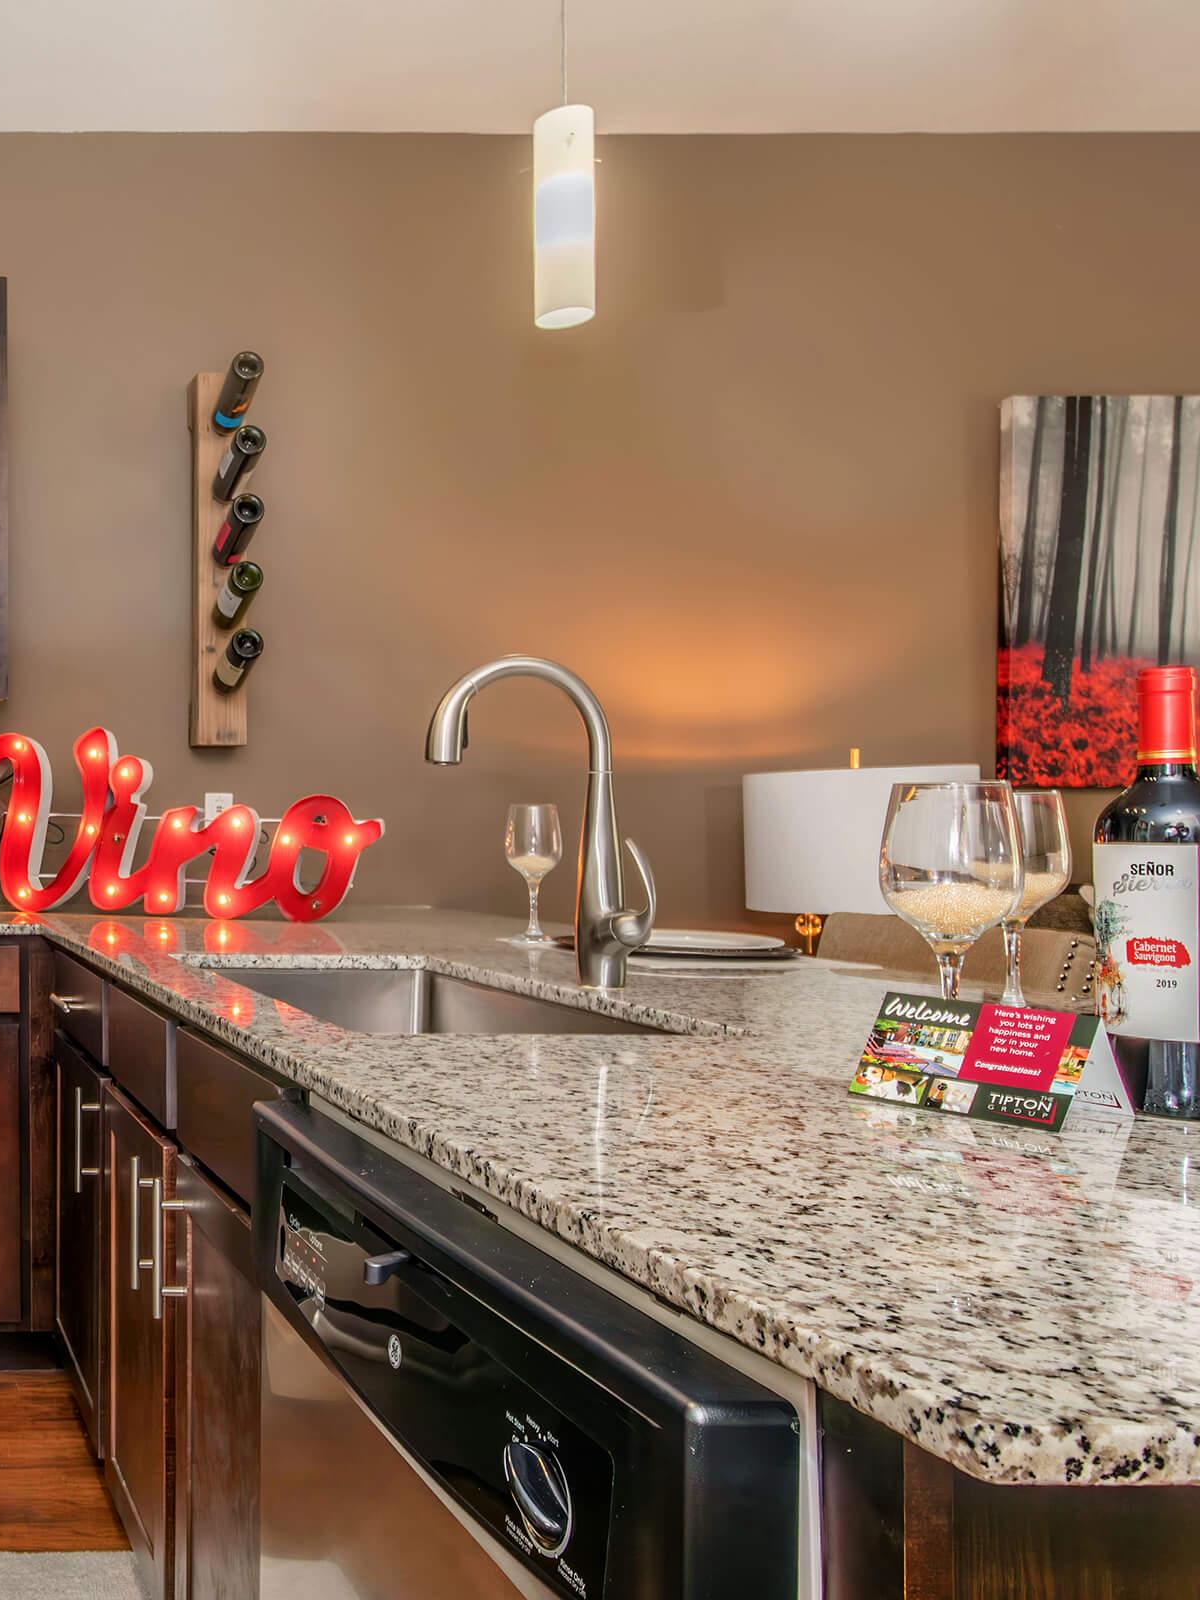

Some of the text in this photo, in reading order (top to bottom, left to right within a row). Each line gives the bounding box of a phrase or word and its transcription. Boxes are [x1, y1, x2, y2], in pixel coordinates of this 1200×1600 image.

[1130, 861, 1175, 876] SEÑOR
[1133, 940, 1177, 954] Cabernet
[1133, 951, 1176, 964] Sauvignon
[1155, 978, 1178, 989] 2019
[885, 997, 972, 1026] Welcome
[994, 1008, 1057, 1025] Here's wishing
[999, 1020, 1045, 1032] you lots of
[988, 1026, 1051, 1042] happiness and
[993, 1036, 1039, 1049] joy in your
[989, 1045, 1036, 1058] new home.
[974, 1060, 1042, 1077] Congratulations!
[990, 1093, 1052, 1113] TIPTON
[987, 1104, 1049, 1120] GROUP
